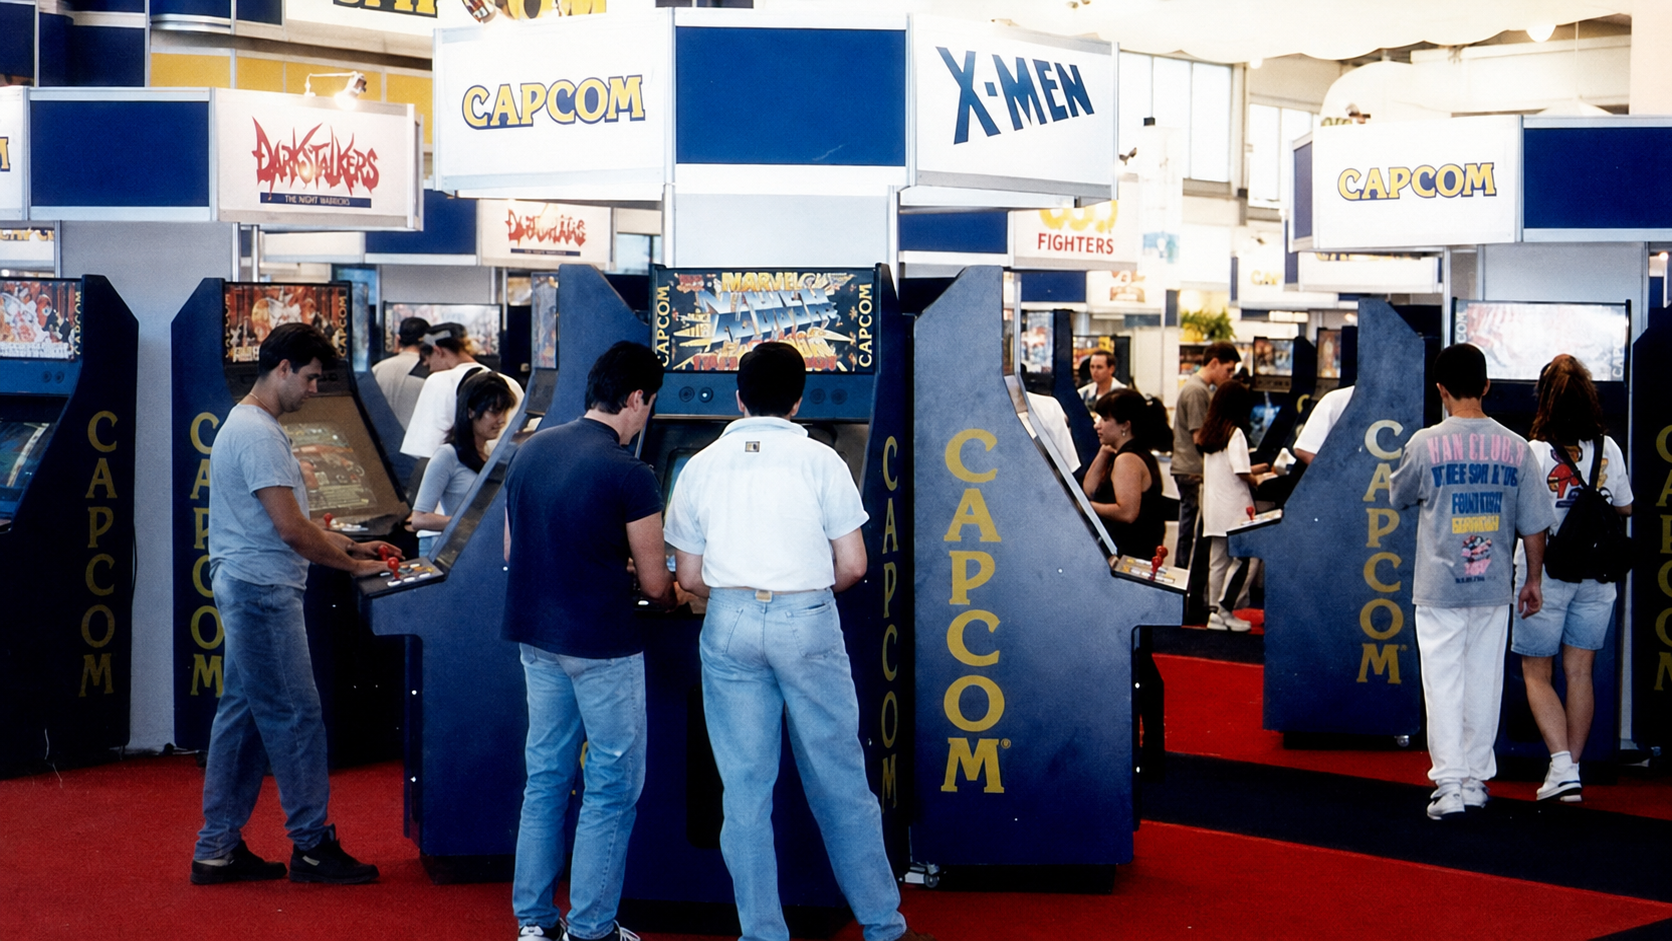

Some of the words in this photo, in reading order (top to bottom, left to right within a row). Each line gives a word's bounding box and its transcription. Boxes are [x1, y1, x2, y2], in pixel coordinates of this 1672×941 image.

[461, 75, 646, 130] CAPCOM
[935, 46, 1095, 145] X-MEN
[252, 116, 379, 197] DARKSTALKERS
[1337, 162, 1497, 201] CAPCOM
[285, 195, 297, 203] THE
[1038, 233, 1114, 254] FIGHTERS
[721, 272, 803, 292] MARVEL
[1251, 270, 1283, 286] CAP
[657, 286, 670, 368] CAPCOM
[859, 284, 873, 367] CAPCOM
[79, 410, 119, 698] CAPCOM
[881, 436, 899, 814] CAPCOM
